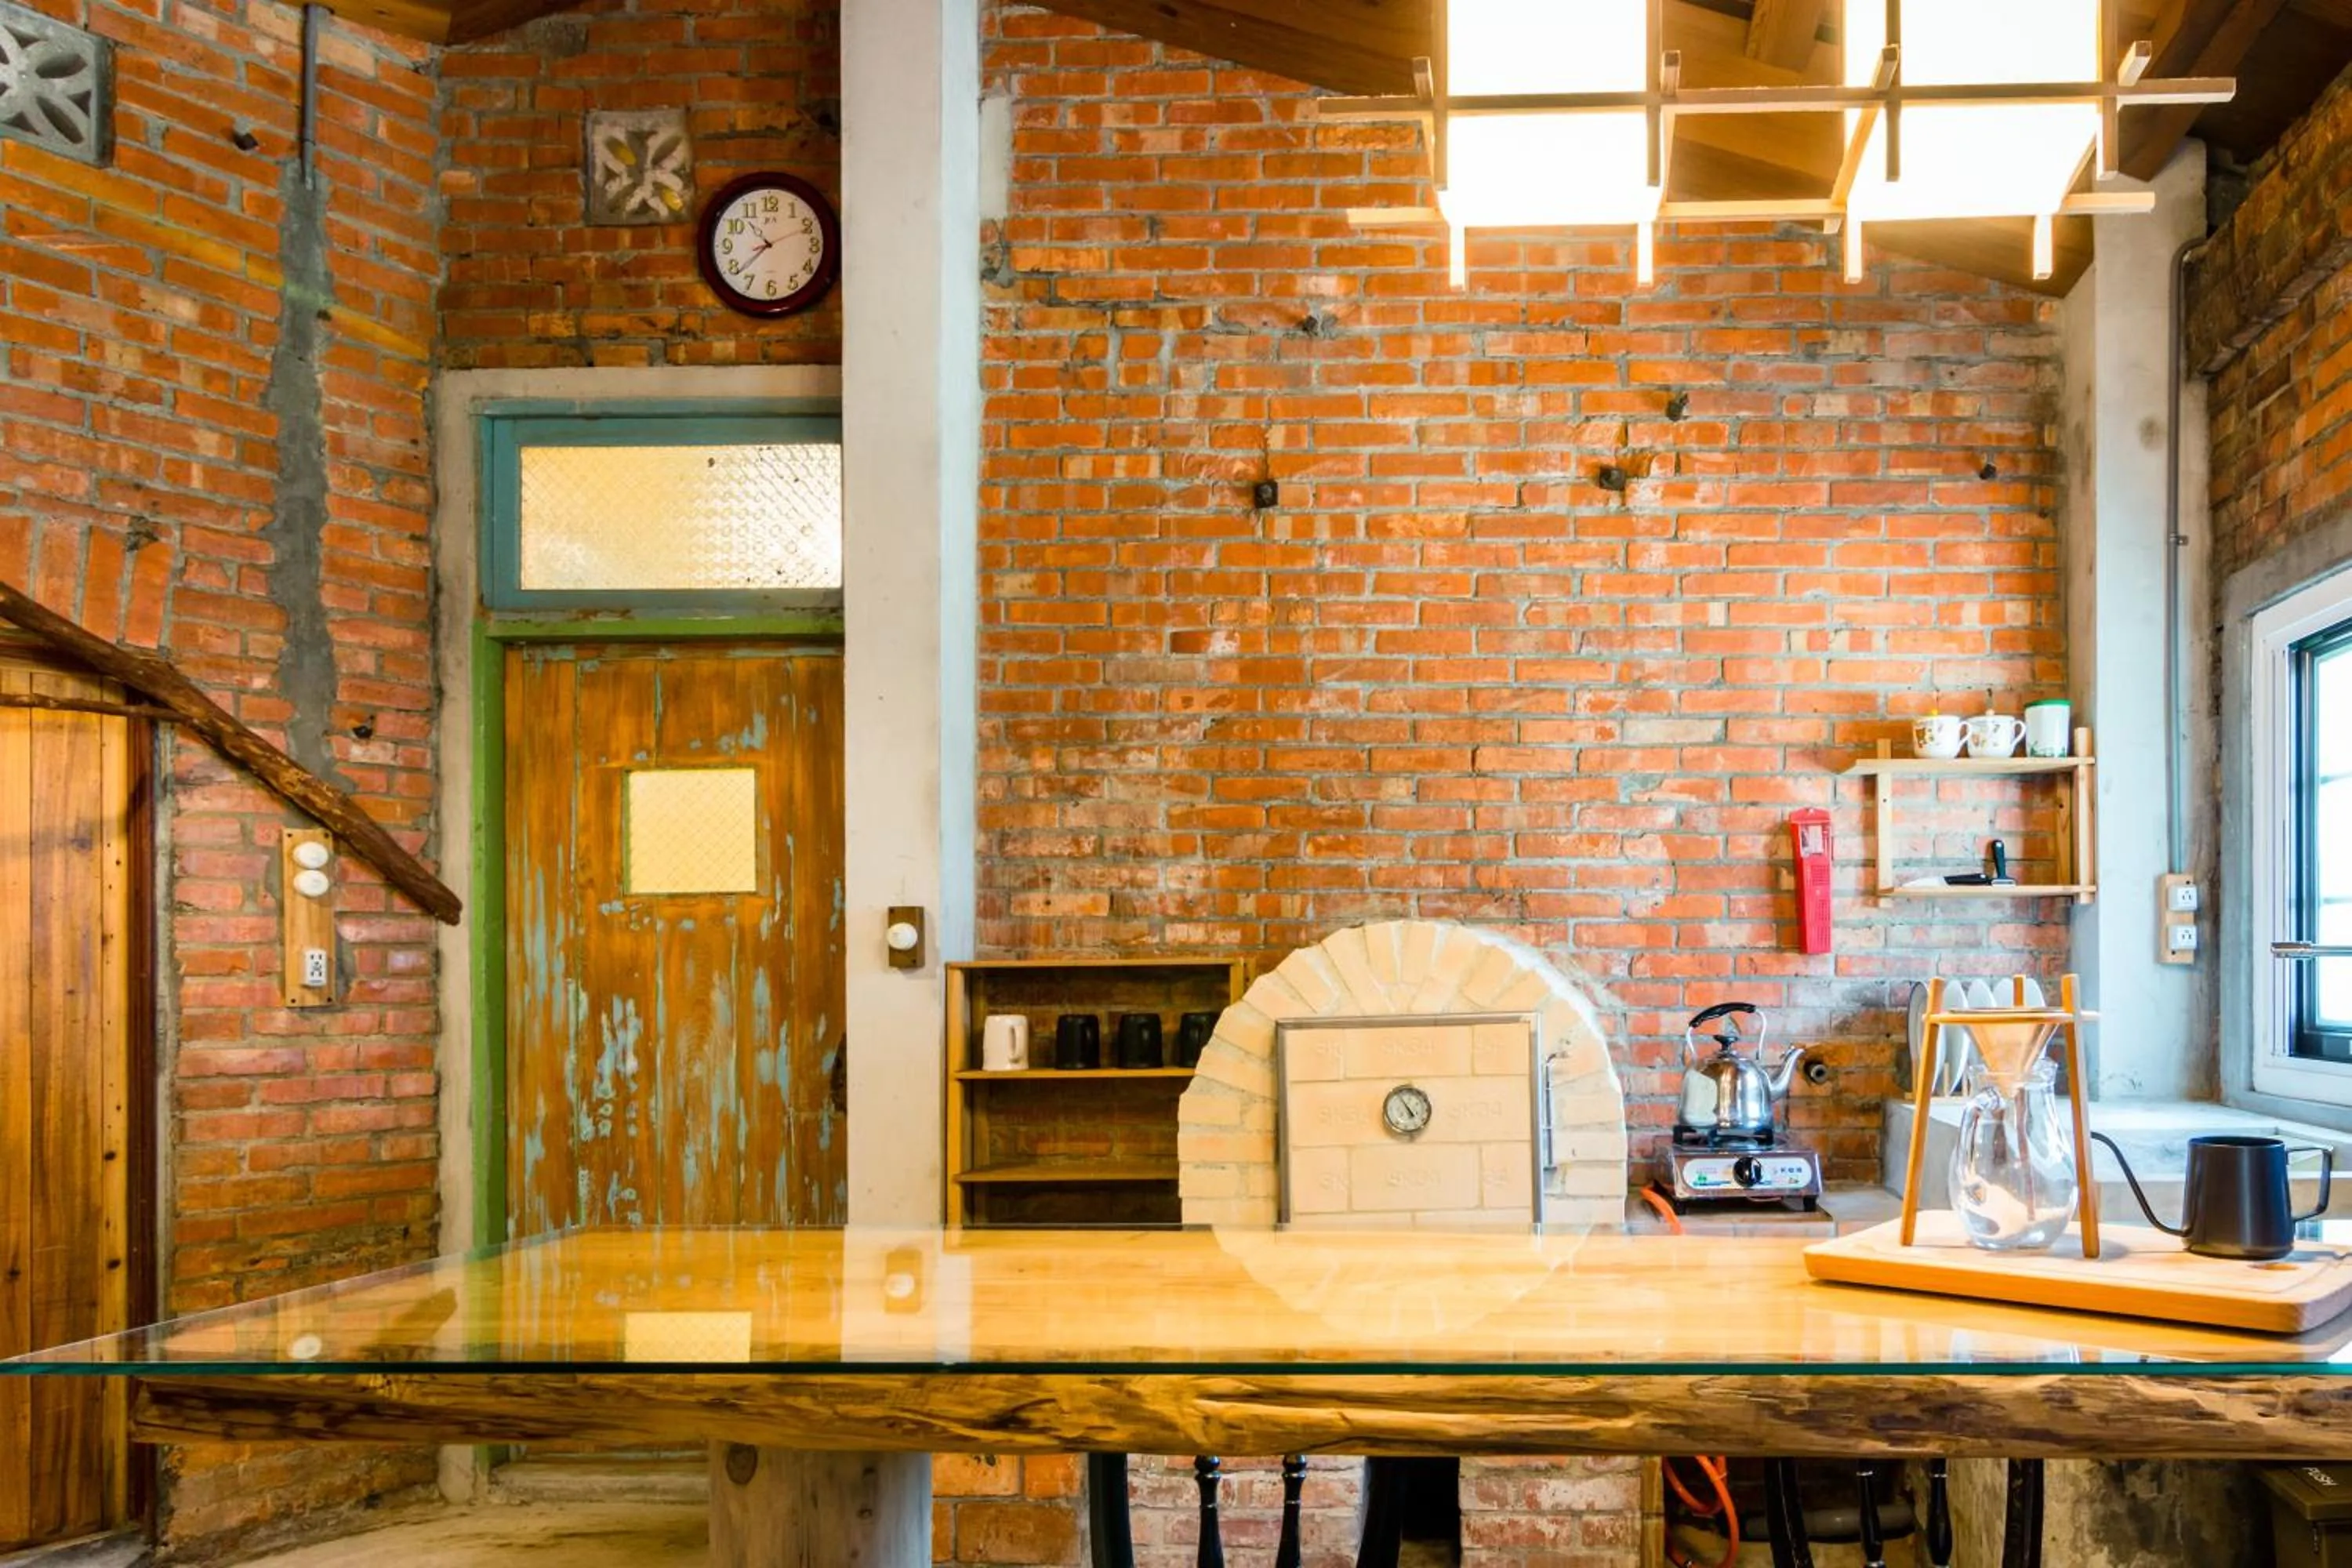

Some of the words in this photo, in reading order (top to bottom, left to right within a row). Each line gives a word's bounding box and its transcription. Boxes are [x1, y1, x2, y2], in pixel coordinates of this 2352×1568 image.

[743, 202, 757, 218] 11
[761, 195, 779, 212] 12
[788, 202, 797, 218] 1
[727, 218, 745, 234] 10
[802, 217, 813, 234] 2
[722, 238, 733, 254] 9
[809, 237, 820, 254] 3
[728, 259, 739, 275] 8
[802, 259, 814, 274] 4
[743, 274, 755, 291] 7
[766, 279, 777, 296] 6
[787, 275, 799, 290] 5
[1381, 1036, 1436, 1056] SK34
